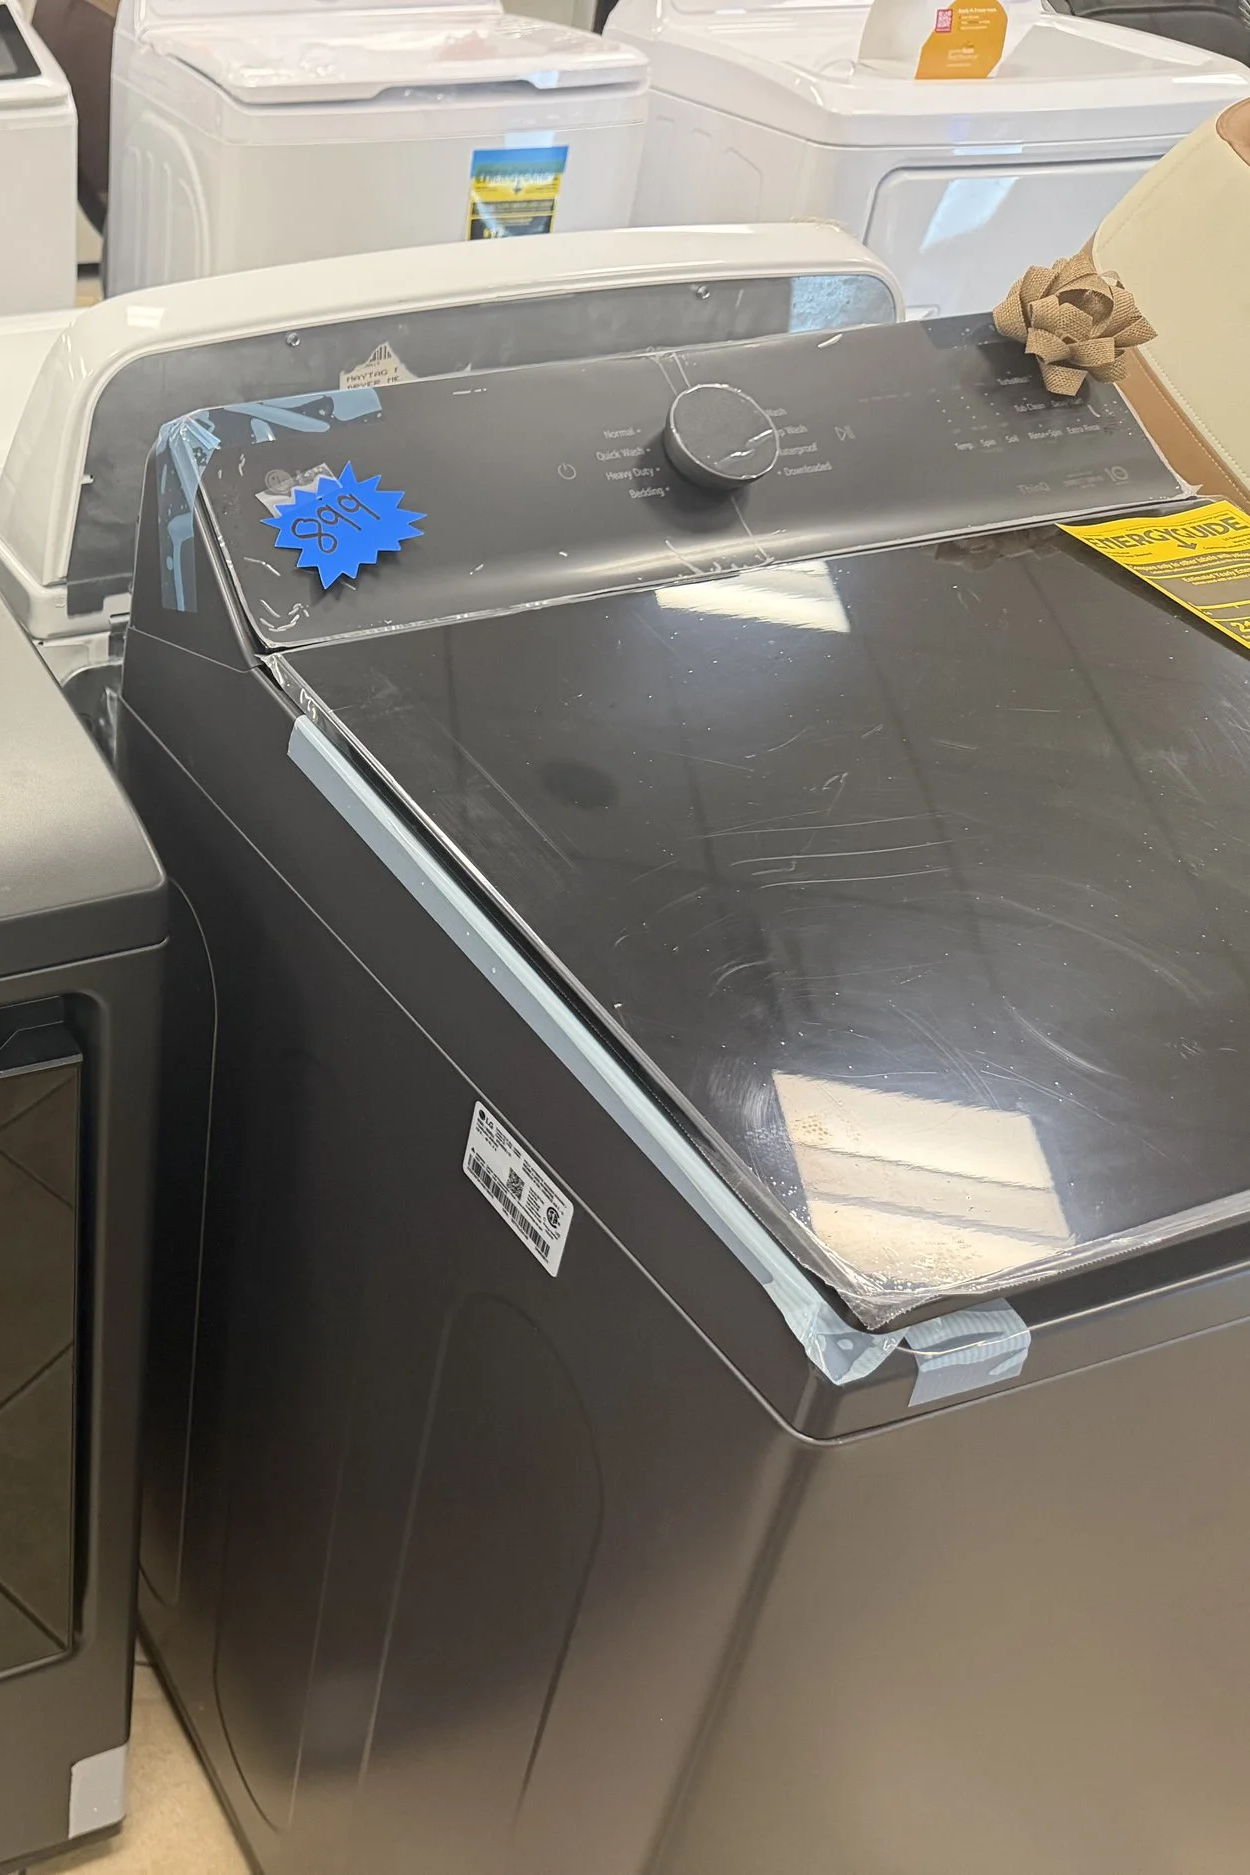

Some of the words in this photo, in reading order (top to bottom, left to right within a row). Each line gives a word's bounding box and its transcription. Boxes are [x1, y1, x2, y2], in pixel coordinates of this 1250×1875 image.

[346, 368, 388, 382] MAYTAG
[603, 427, 635, 439] Normal
[784, 425, 808, 434] Wash
[595, 450, 621, 461] Quick
[621, 446, 645, 457] Wash
[779, 442, 817, 456] aterproof
[605, 470, 632, 481] Heavy
[632, 467, 654, 477] Duty
[783, 461, 833, 476] Downloaded
[629, 486, 666, 499] Bedding
[291, 493, 381, 554] 899
[485, 1117, 494, 1130] LG
